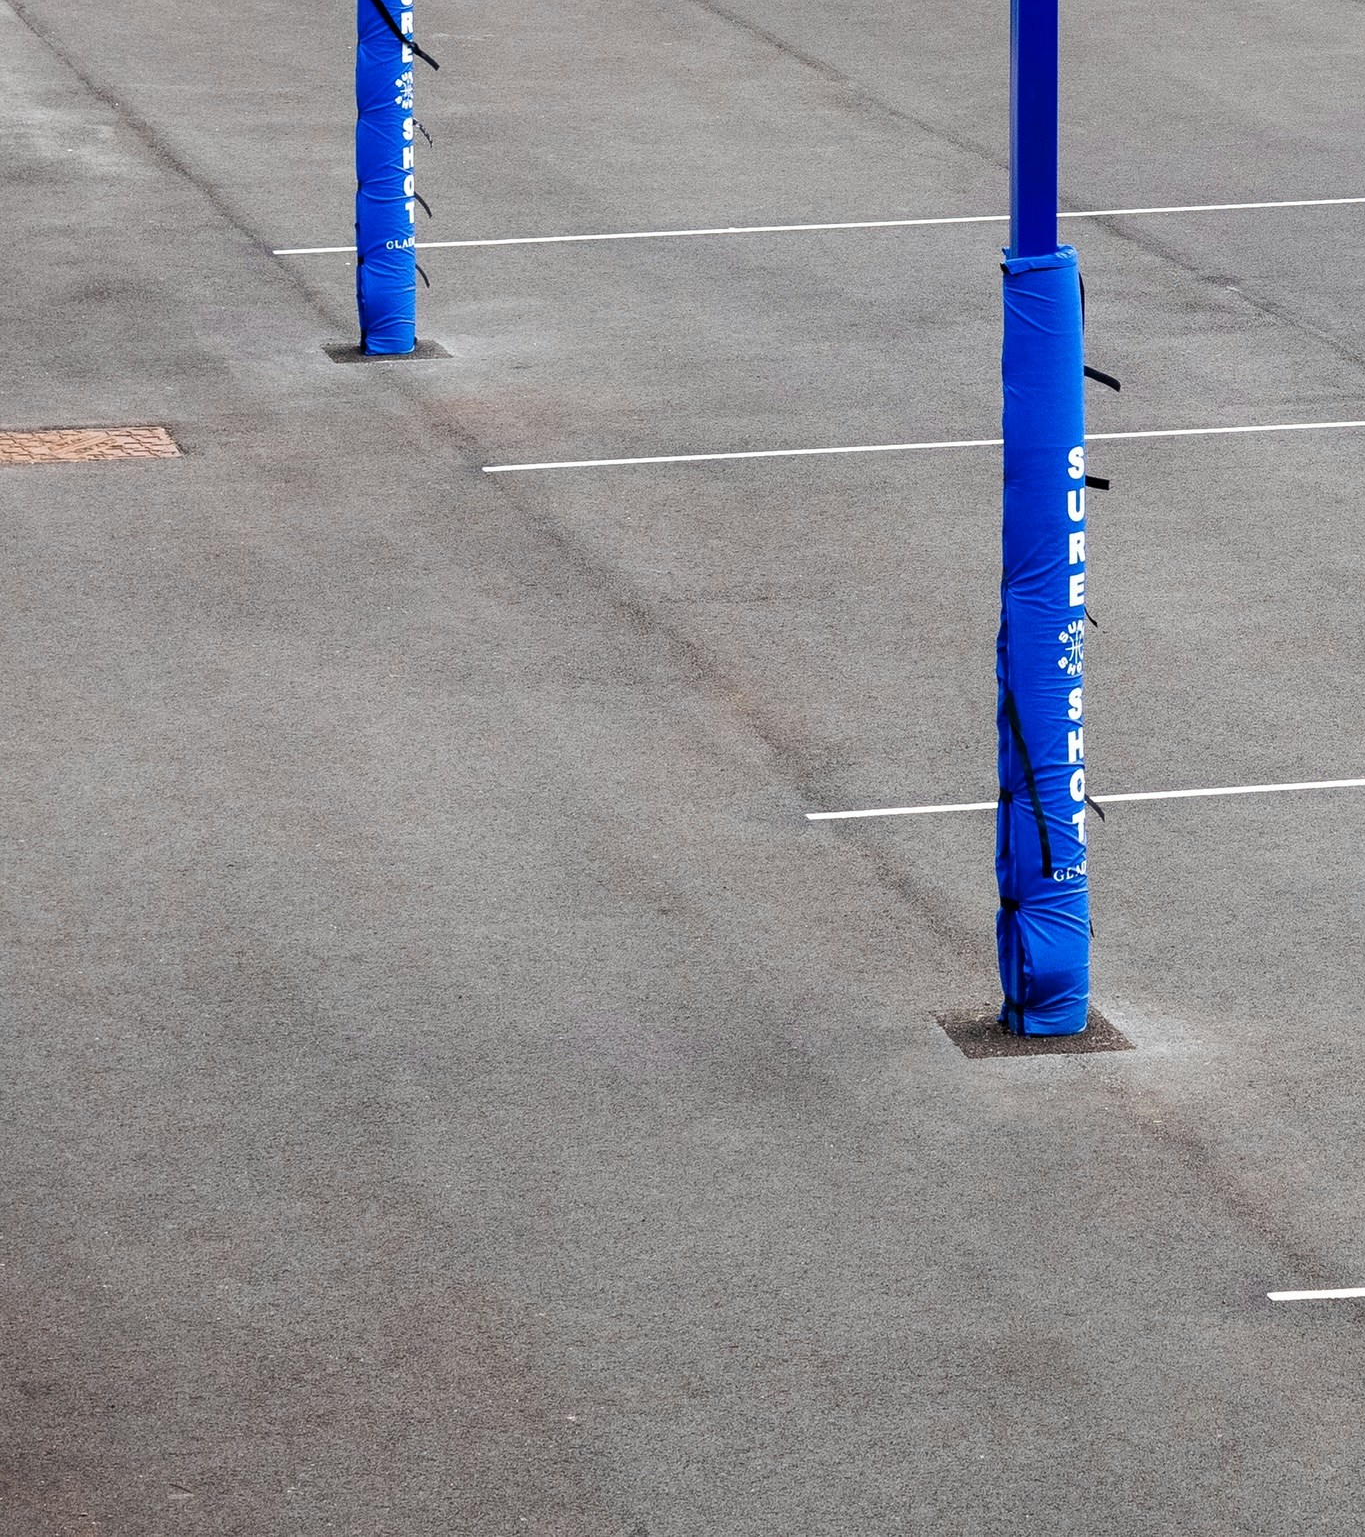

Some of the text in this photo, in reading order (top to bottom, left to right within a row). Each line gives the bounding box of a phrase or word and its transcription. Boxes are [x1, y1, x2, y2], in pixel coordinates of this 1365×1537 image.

[402, 117, 414, 224] SHOT
[1067, 446, 1085, 607] SURE
[1067, 687, 1085, 843] SHOT
